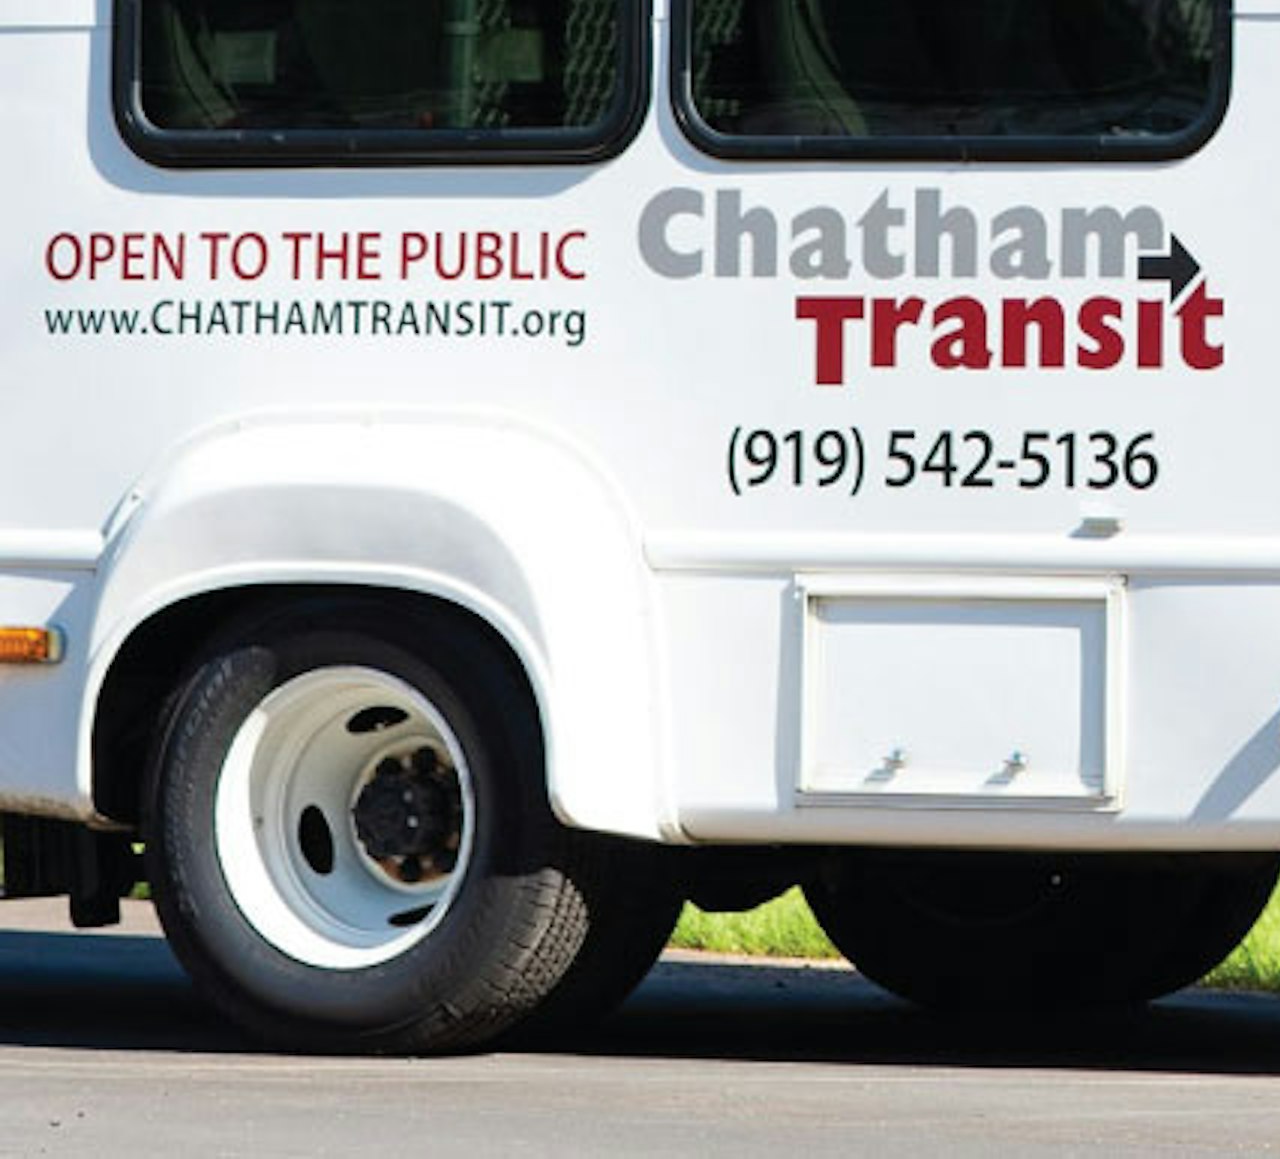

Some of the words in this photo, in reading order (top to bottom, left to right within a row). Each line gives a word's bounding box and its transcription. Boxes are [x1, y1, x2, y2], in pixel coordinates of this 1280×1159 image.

[45, 231, 186, 281] OPEN
[199, 231, 269, 281] TO
[281, 231, 382, 280] THE
[400, 230, 587, 281] PUBLIC
[637, 186, 1164, 280] Chatham
[44, 300, 586, 347] www.CHATHAMTRANSIT.org
[796, 277, 1223, 385] Transit
[727, 426, 865, 497] (919)
[884, 429, 1159, 490] 542-5136
